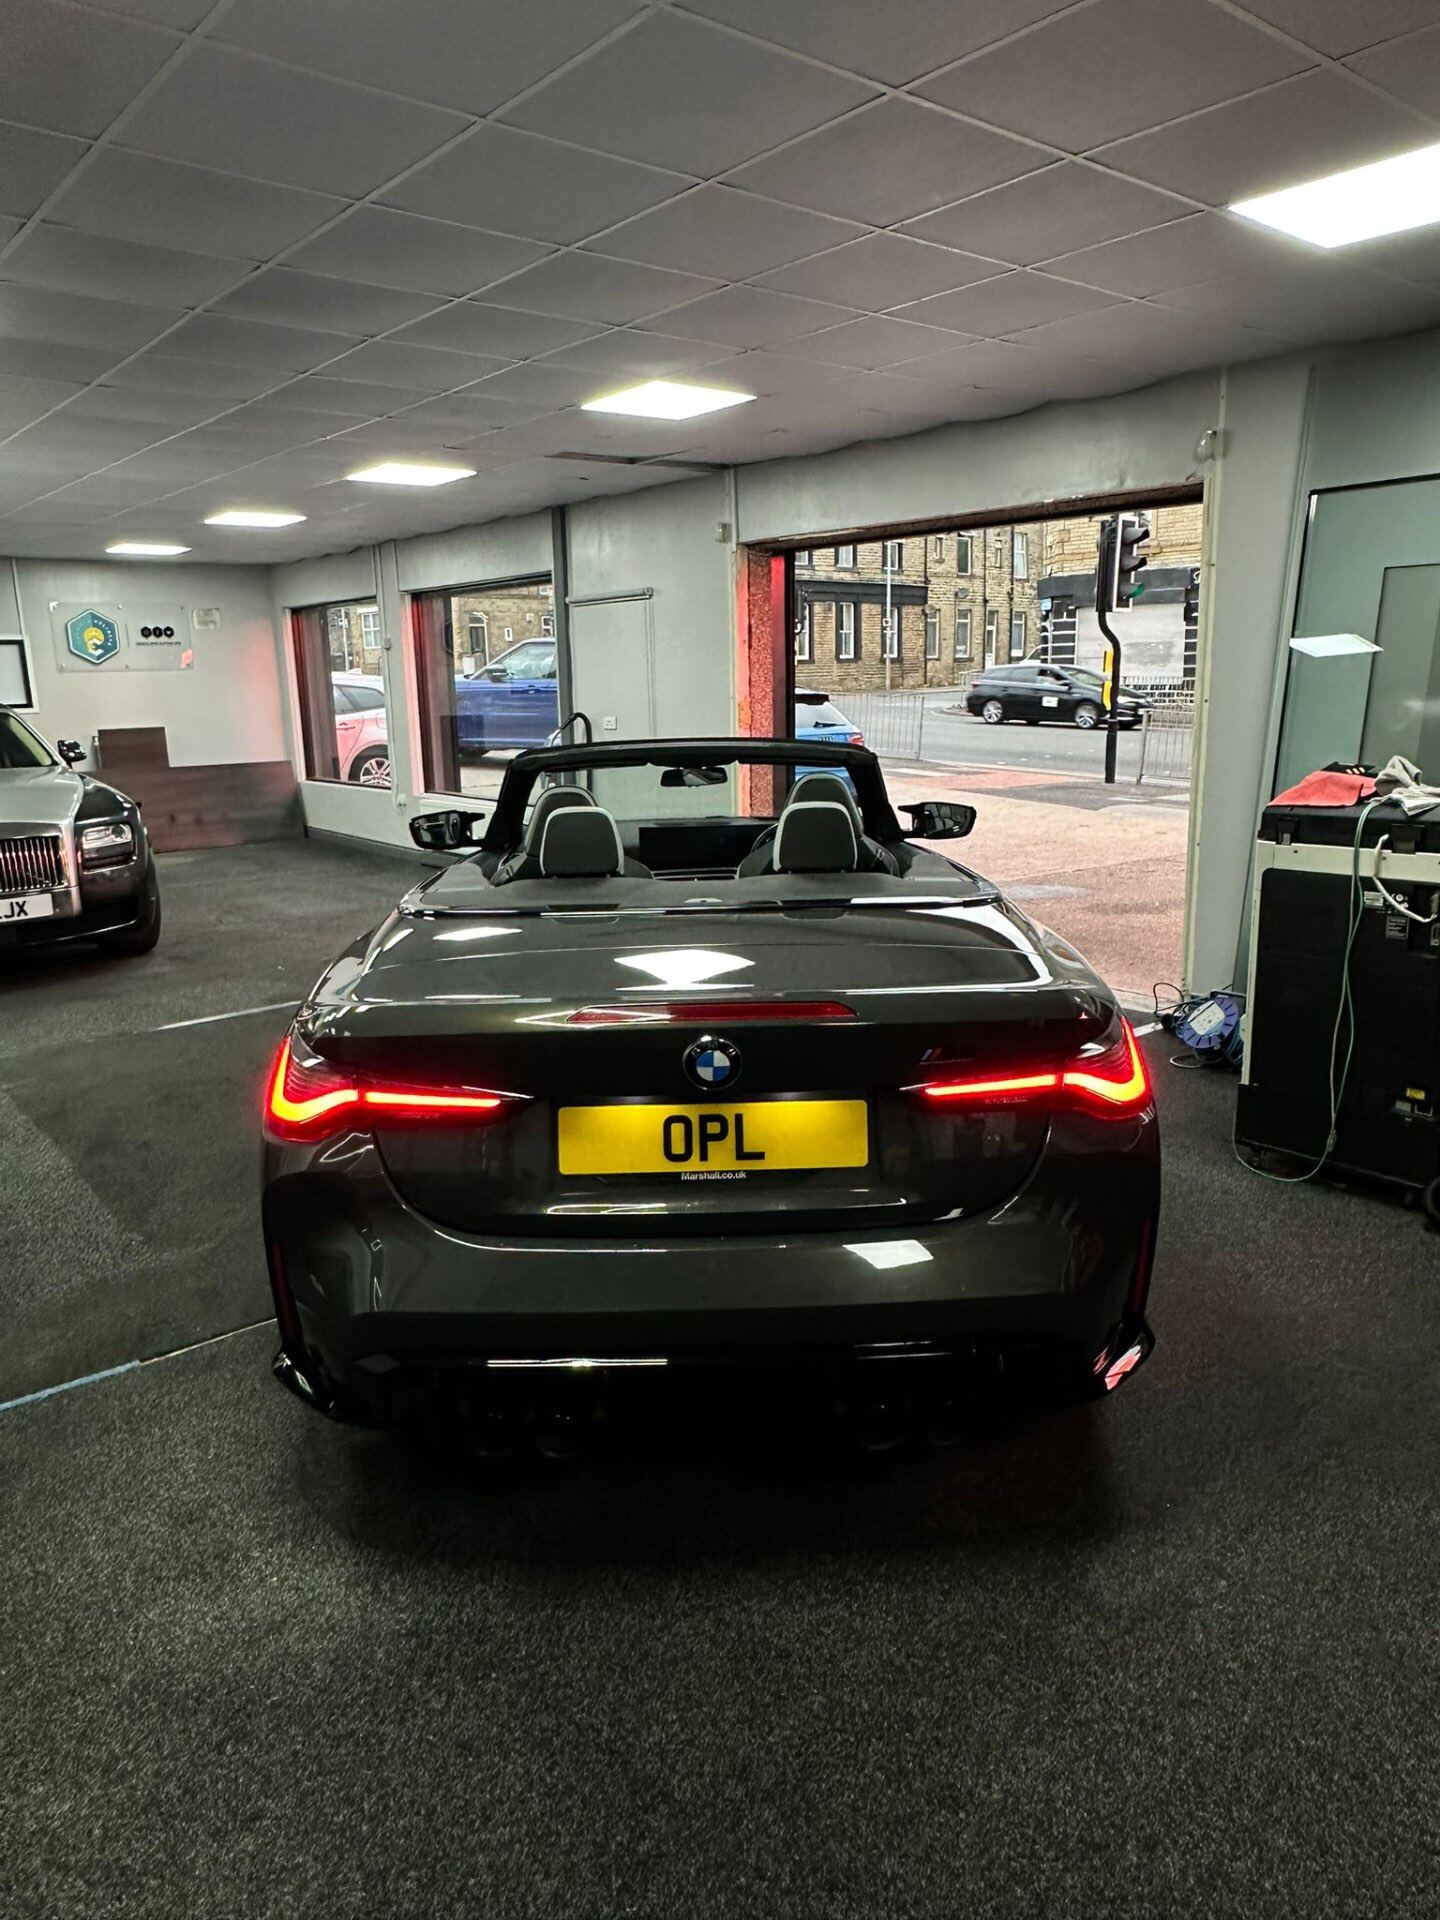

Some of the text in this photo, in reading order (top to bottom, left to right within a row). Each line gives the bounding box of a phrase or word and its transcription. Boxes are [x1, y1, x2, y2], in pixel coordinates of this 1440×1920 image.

[0, 900, 28, 919] JX
[663, 1113, 765, 1162] OPL
[681, 1171, 747, 1181] Marshall.co.uk
